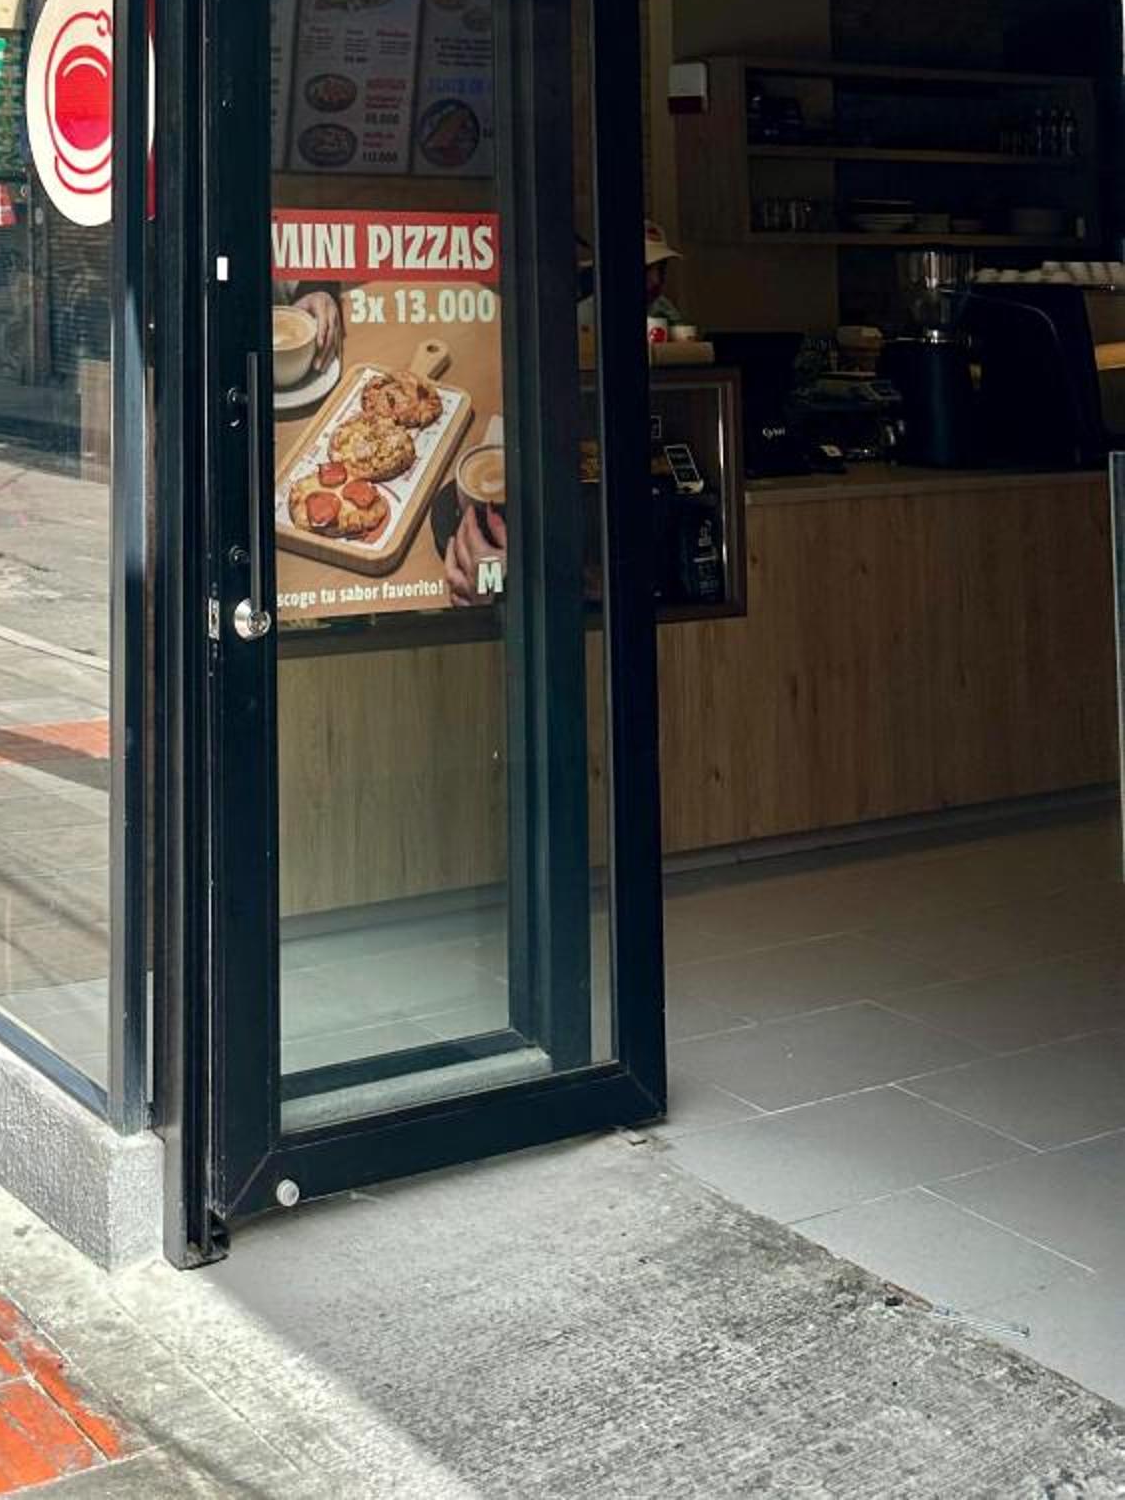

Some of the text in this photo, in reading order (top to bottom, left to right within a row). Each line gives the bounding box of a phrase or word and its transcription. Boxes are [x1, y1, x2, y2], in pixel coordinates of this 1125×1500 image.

[271, 223, 495, 271] MINI PIZZAS
[350, 288, 496, 324] 3x 13.000
[276, 579, 444, 609] scoge tu sabor favorito!
